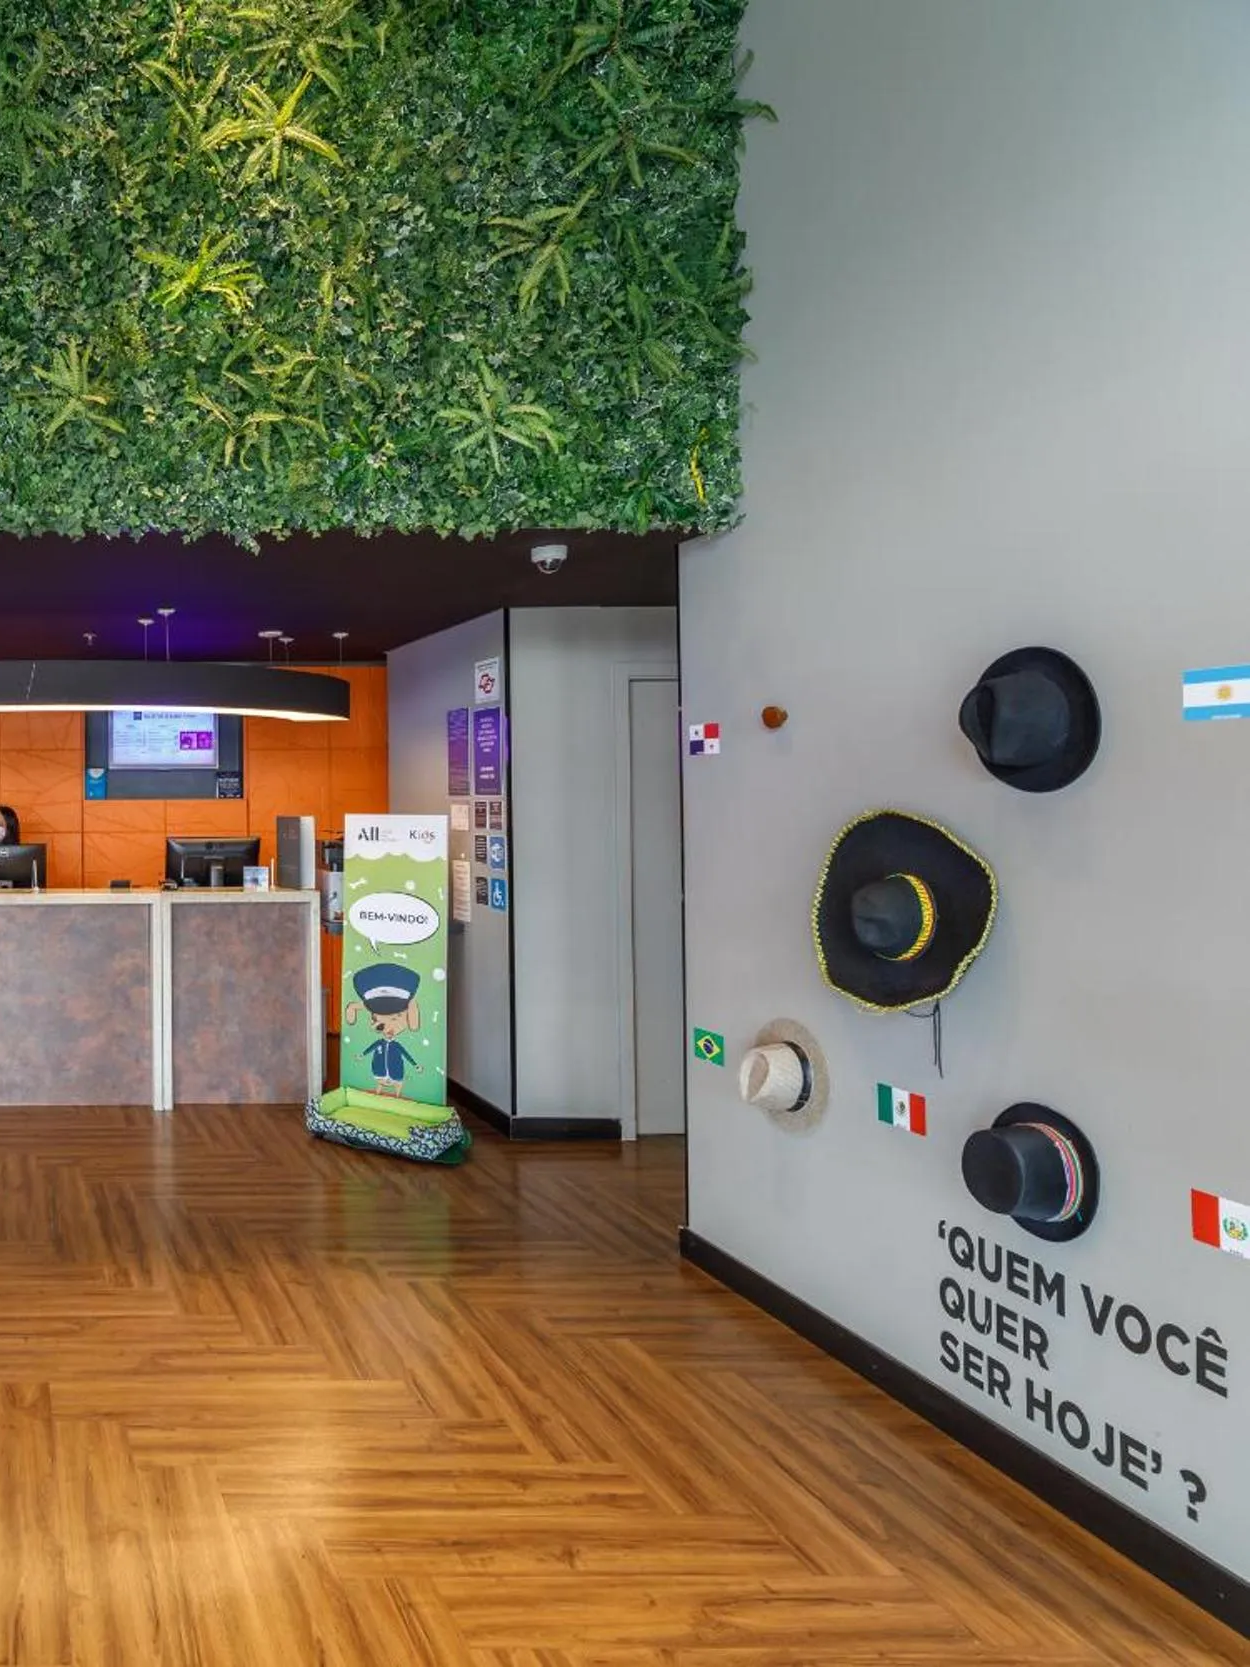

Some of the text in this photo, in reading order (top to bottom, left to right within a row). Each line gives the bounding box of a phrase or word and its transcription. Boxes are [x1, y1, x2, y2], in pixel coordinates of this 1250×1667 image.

[359, 911, 429, 925] BEM-VINDO!
[939, 1276, 1050, 1371] QUER
[1080, 1283, 1229, 1400] VOCÊ
[939, 1330, 1012, 1409] SER
